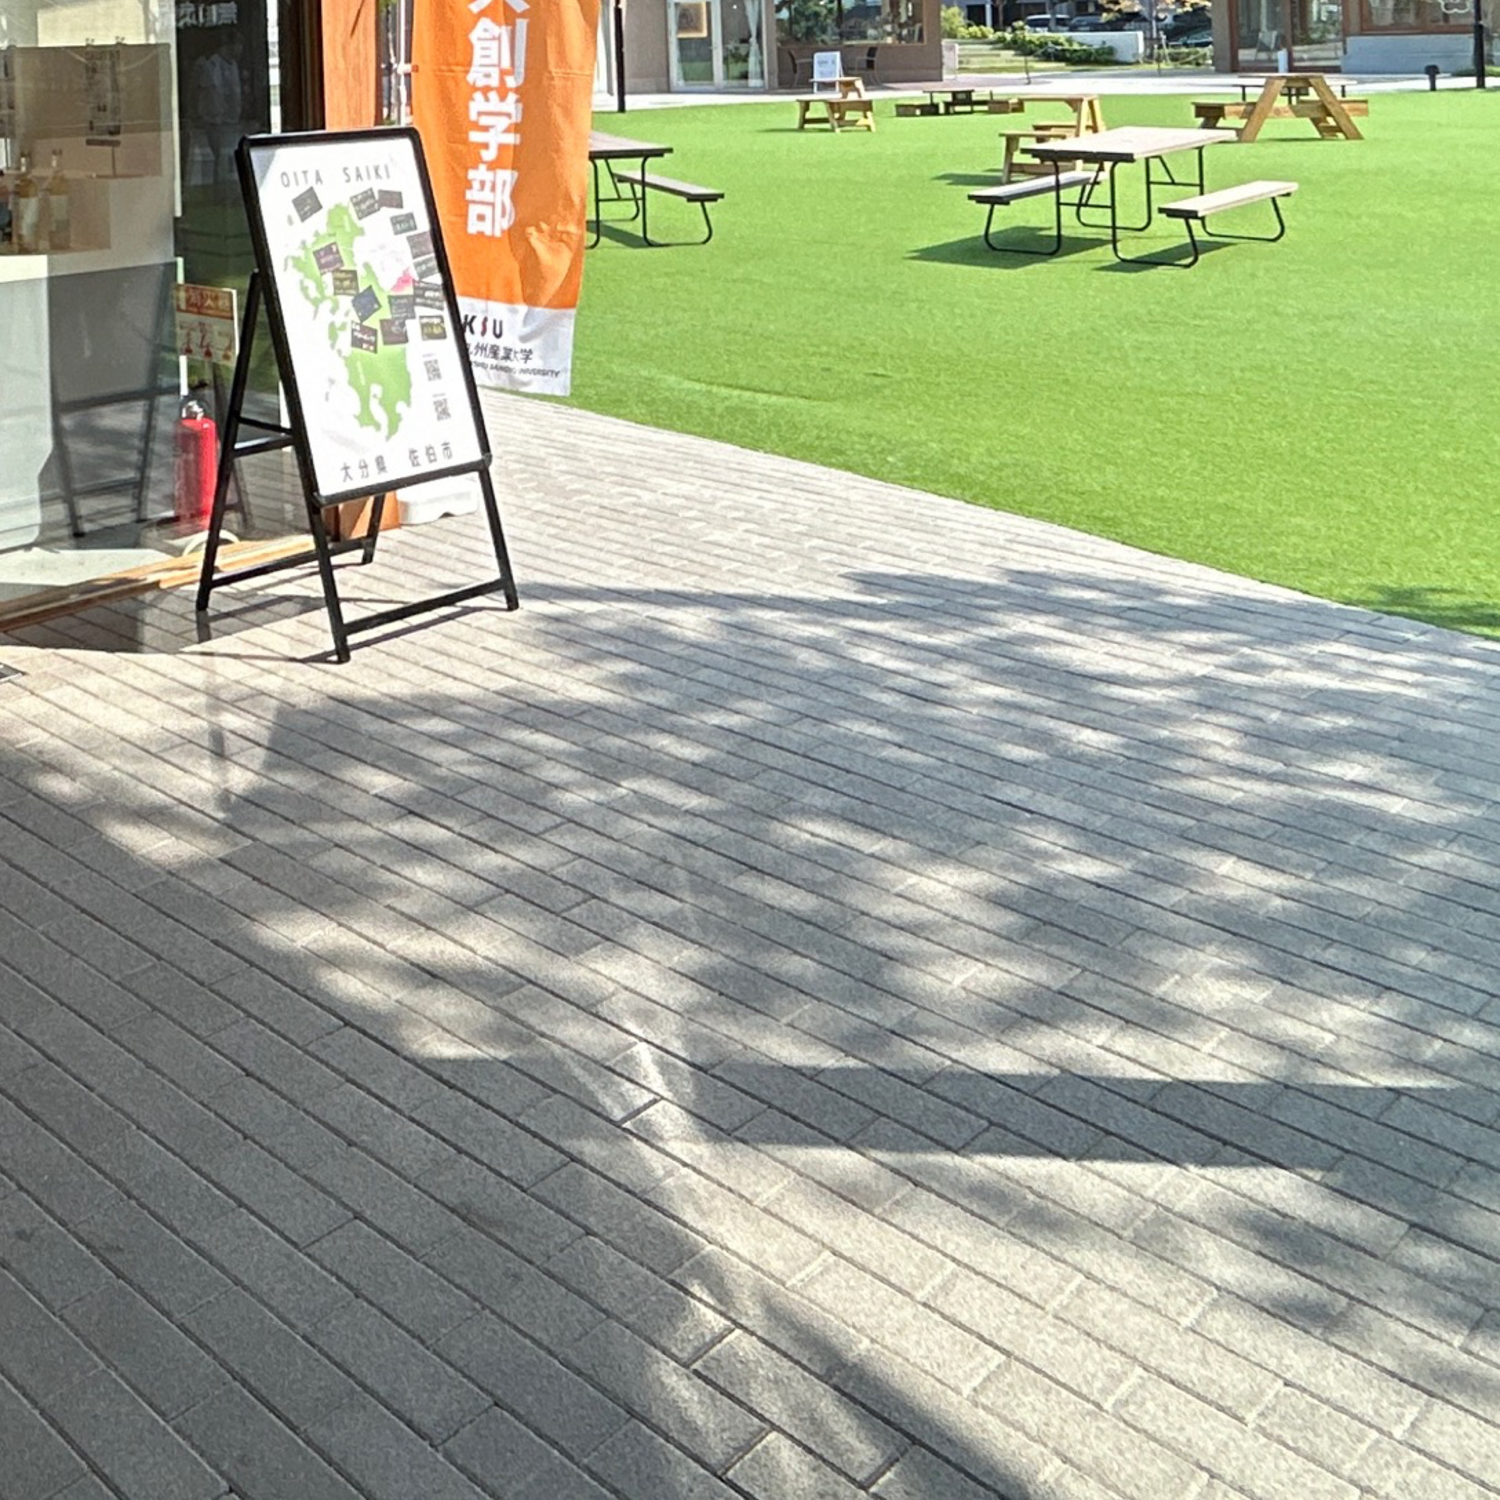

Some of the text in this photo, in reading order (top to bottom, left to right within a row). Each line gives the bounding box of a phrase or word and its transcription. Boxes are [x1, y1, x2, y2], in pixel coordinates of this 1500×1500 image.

[280, 164, 391, 188] OITA SAIKI
[463, 314, 503, 339] KSU
[408, 441, 453, 467] 佐伯市
